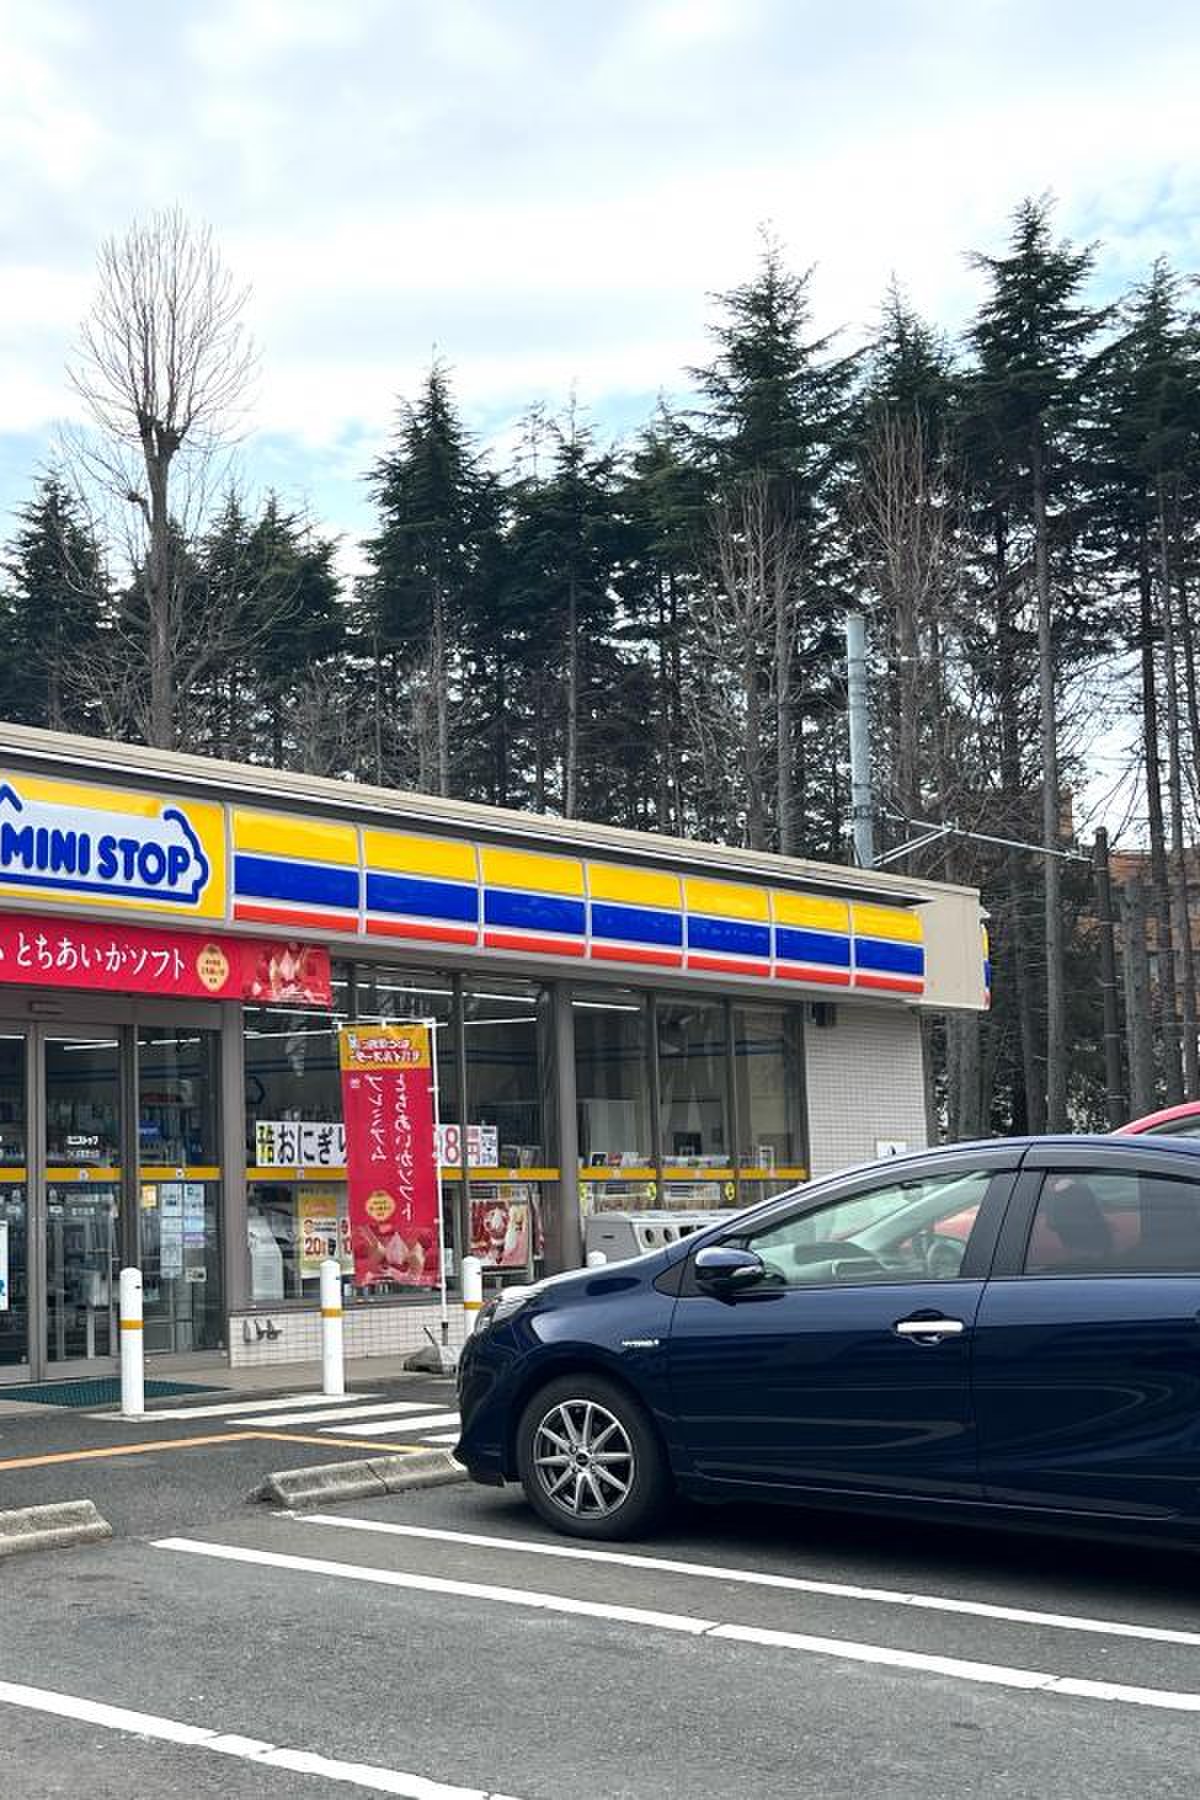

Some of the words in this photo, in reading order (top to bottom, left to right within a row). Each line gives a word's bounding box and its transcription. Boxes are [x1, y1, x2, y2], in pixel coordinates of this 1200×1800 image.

[0, 820, 90, 876] MINI
[97, 838, 191, 887] STOP
[15, 930, 186, 982] とちあいかソフト
